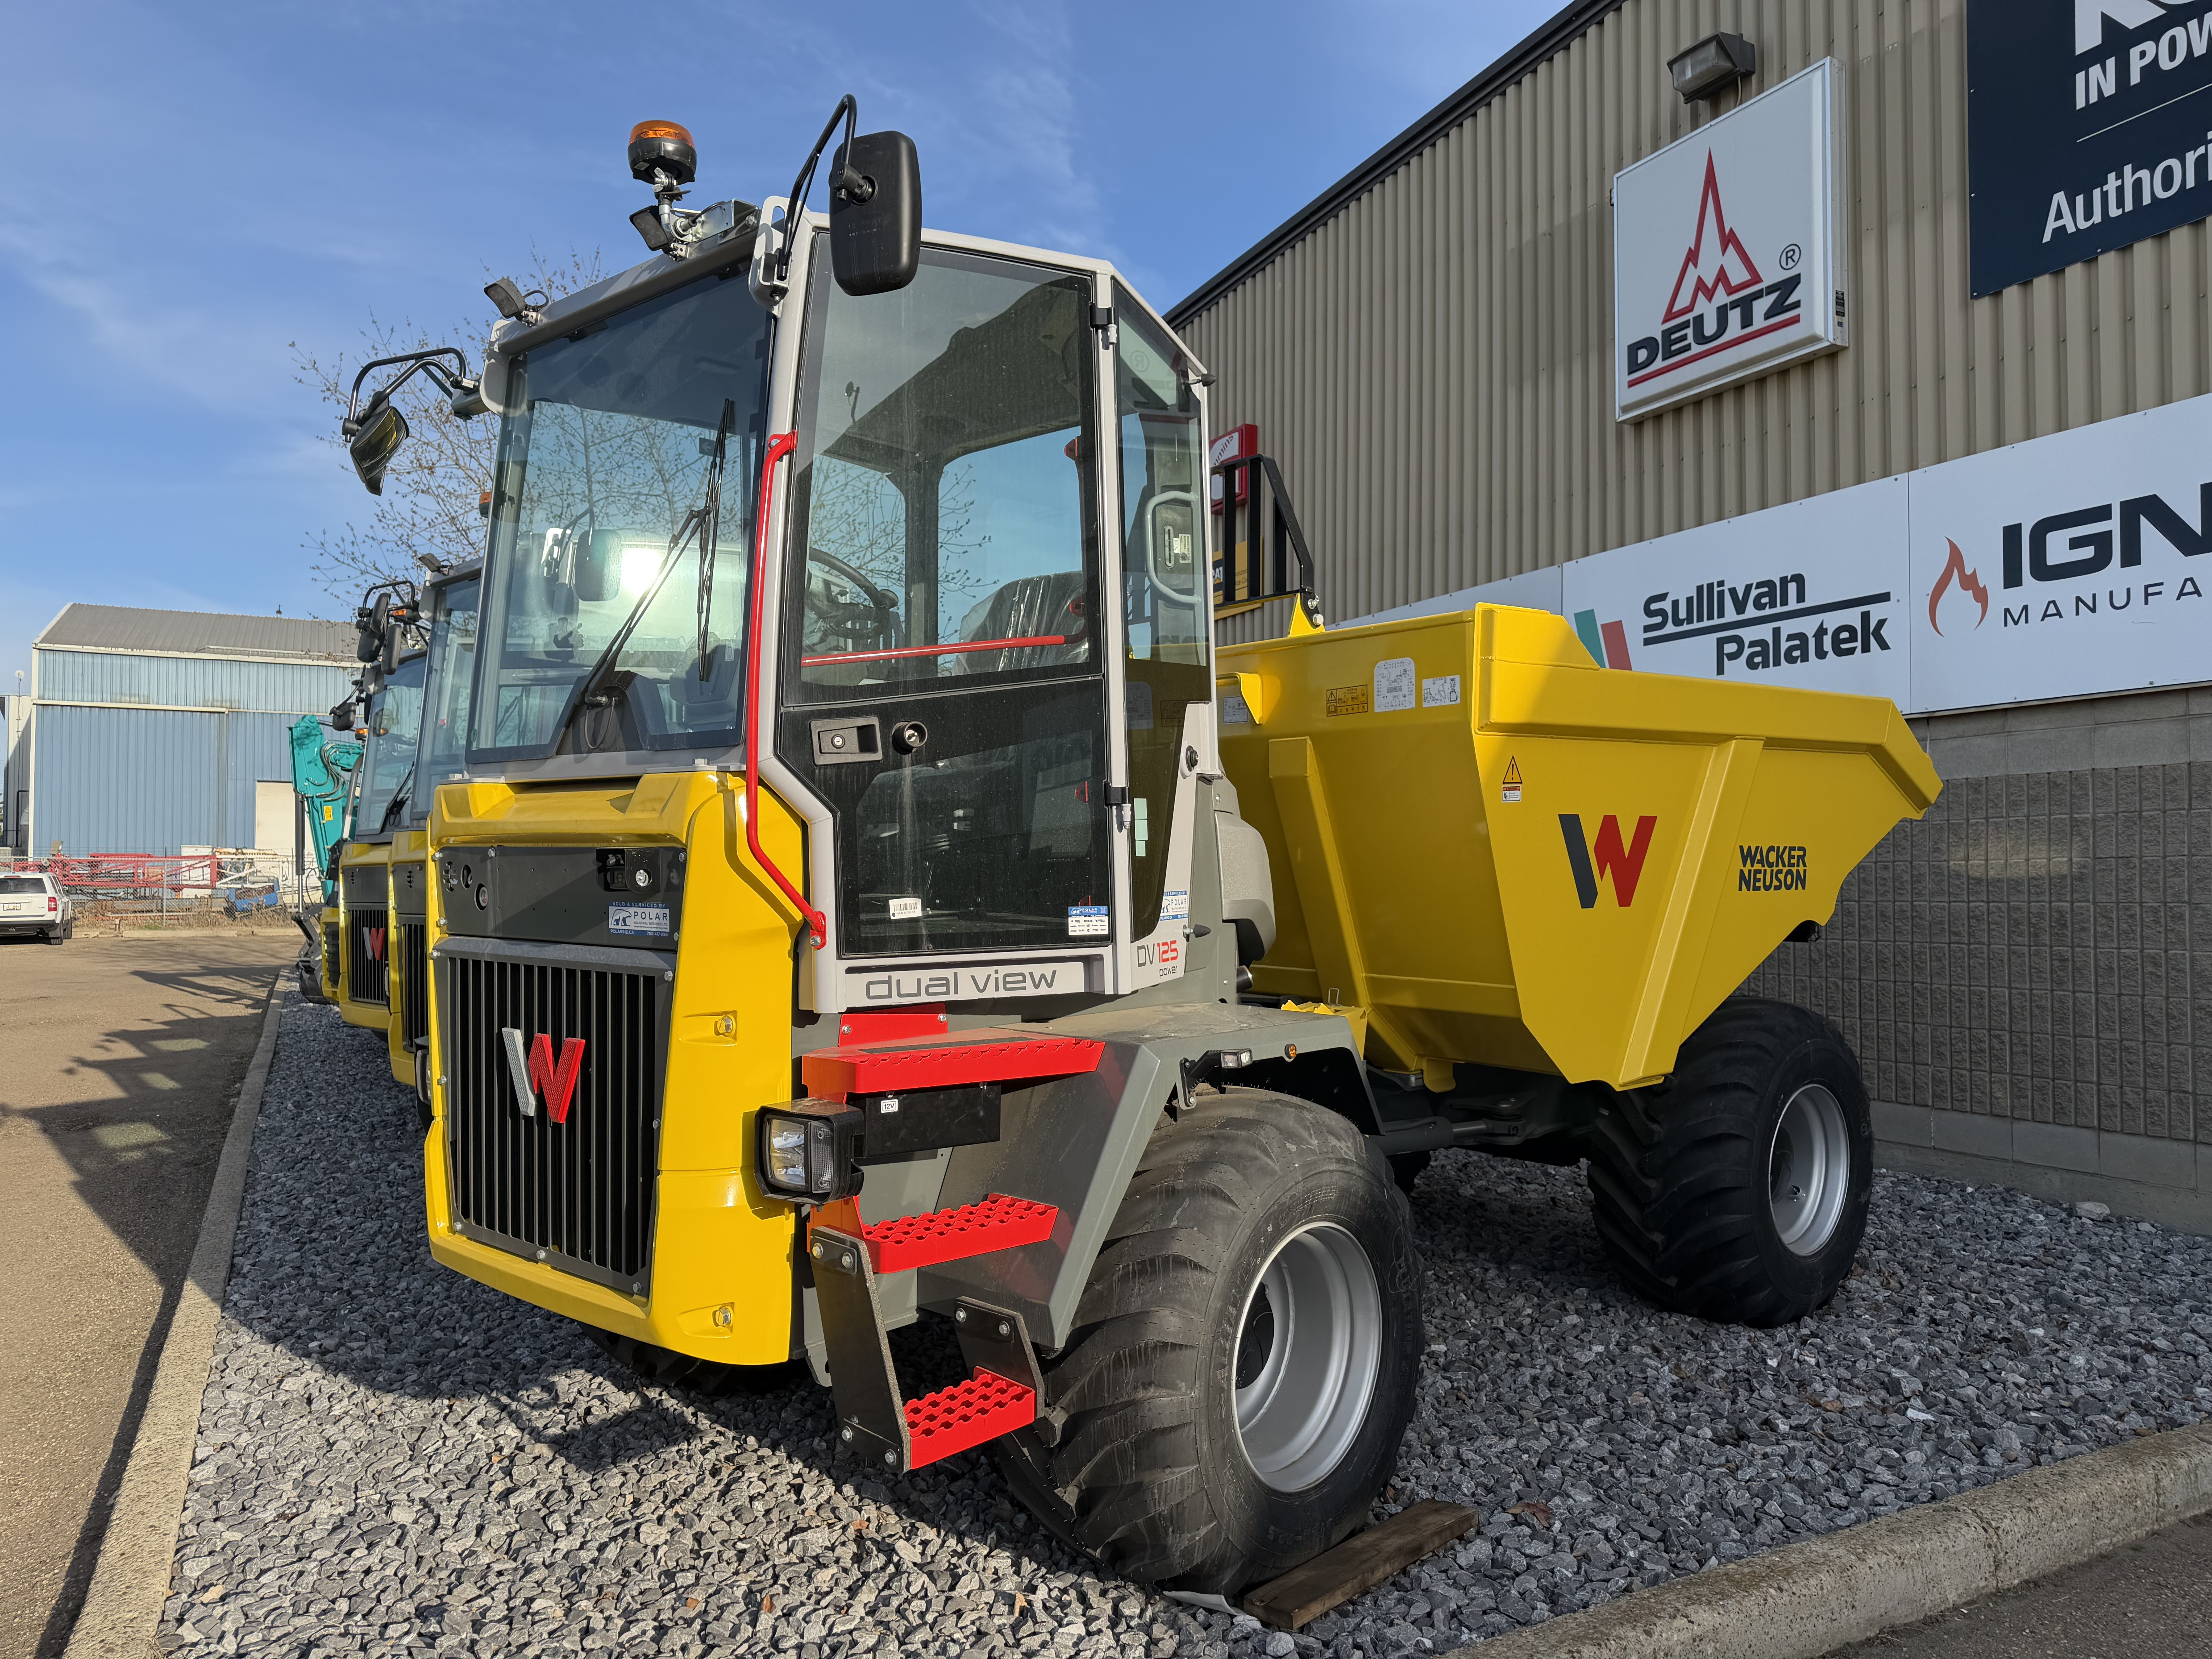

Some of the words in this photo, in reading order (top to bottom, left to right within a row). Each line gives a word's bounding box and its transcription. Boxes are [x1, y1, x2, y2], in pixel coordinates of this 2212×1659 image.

[2076, 57, 2116, 110] IN
[1627, 273, 1801, 376] DEUTZ
[2002, 482, 2212, 589] IGN
[1643, 573, 1806, 634] Sullivan
[2004, 577, 2203, 627] MANUFA
[1716, 610, 1891, 676] Palatek
[1738, 869, 1807, 891] NEUSON
[1739, 845, 1807, 868] WACKER
[634, 911, 668, 921] POLAR
[866, 971, 958, 1000] dual
[970, 969, 1057, 993] view
[1159, 965, 1177, 979] power
